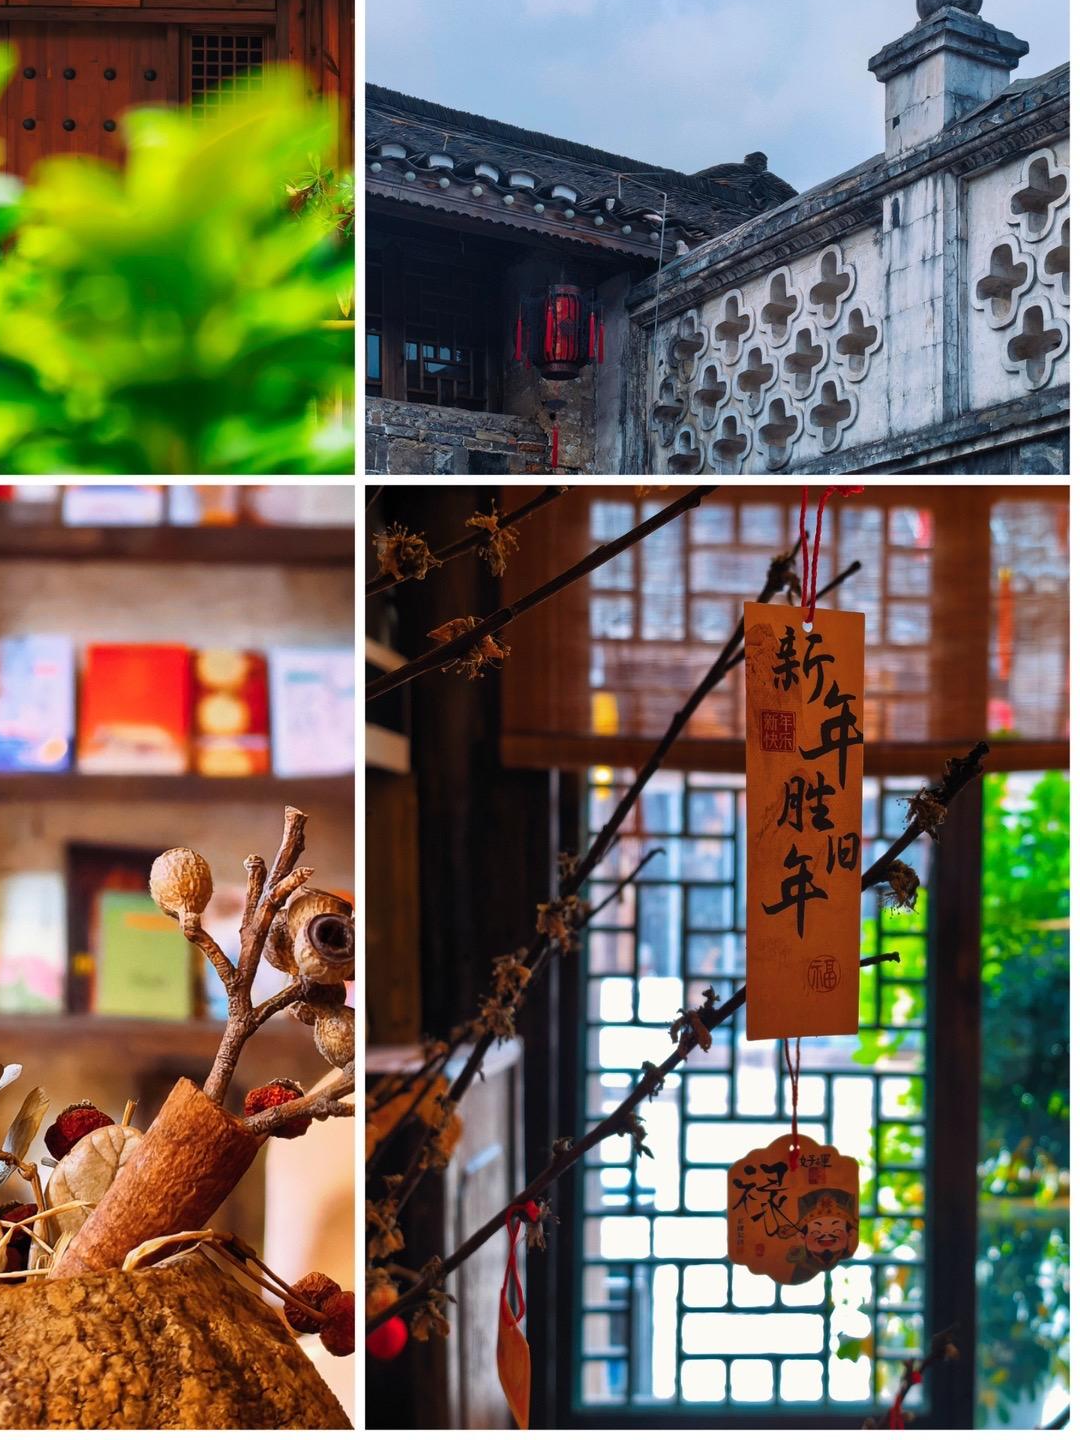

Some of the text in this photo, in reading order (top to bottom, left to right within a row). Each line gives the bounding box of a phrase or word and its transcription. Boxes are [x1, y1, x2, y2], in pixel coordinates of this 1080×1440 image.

[761, 625, 864, 939] 新年胜旧年
[810, 958, 839, 992] 福
